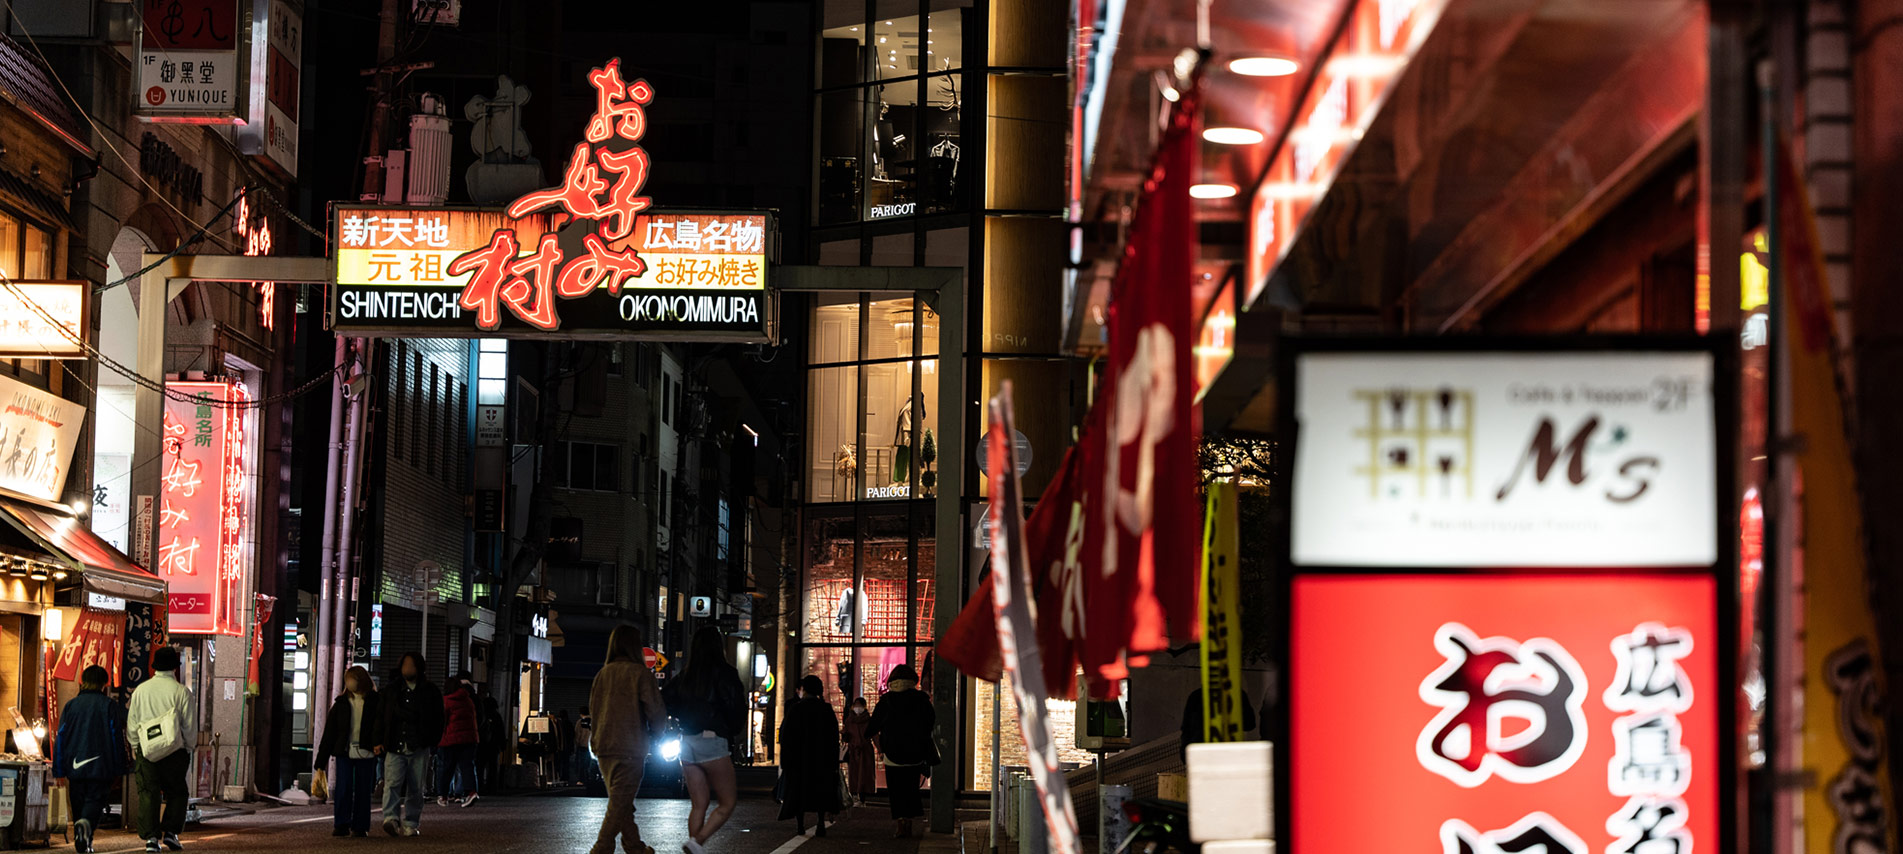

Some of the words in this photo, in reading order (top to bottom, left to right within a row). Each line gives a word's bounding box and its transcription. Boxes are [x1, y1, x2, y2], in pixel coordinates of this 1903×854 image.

[143, 56, 156, 65] 1F
[170, 89, 227, 104] YUNIQUE
[871, 203, 917, 217] PARIGOT
[342, 215, 450, 248] 新天地
[643, 218, 763, 252] 広島名物
[368, 252, 445, 282] 元祖
[655, 257, 759, 286] お好み焼き
[619, 294, 759, 323] OKONOMIMURA
[194, 390, 213, 448] 広島名所
[866, 487, 911, 499] PARIGOT
